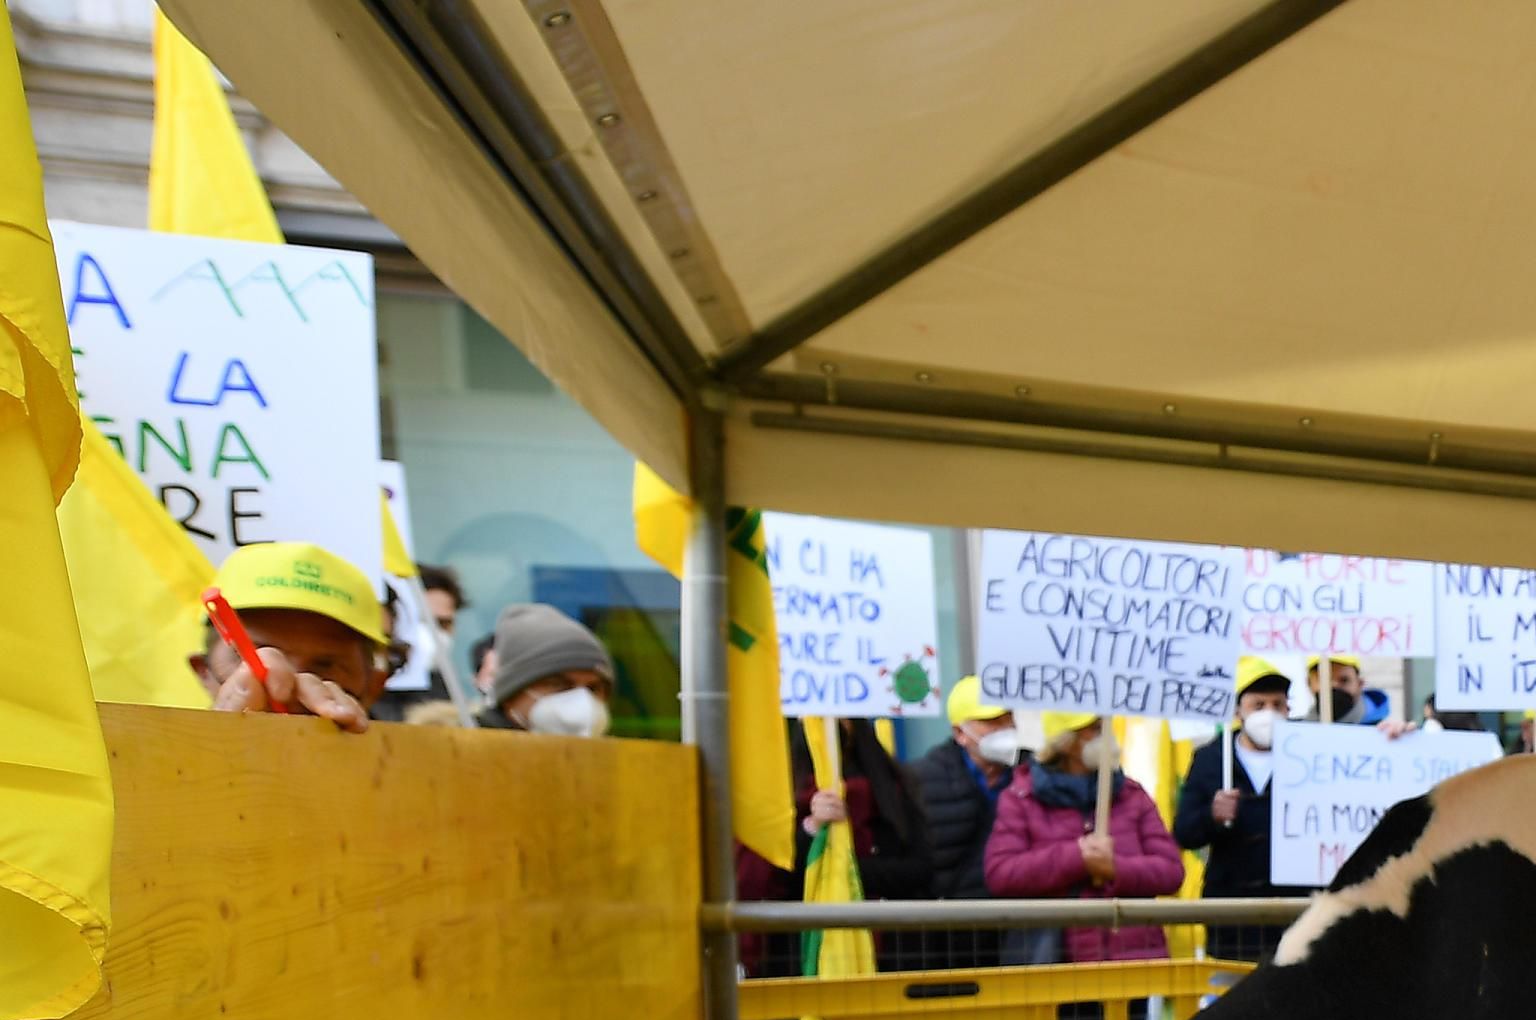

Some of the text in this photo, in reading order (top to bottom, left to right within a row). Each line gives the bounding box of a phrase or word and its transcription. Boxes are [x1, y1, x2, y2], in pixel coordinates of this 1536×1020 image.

[168, 352, 268, 409] LA
[161, 484, 276, 547] RE
[850, 546, 884, 588] HA
[1017, 534, 1230, 599] AGRICOLTORI
[986, 578, 1232, 638] E CONSUMATORI
[1243, 582, 1302, 614] CON
[857, 637, 887, 665] IL
[1047, 623, 1188, 676] VITTIME
[982, 662, 1232, 717] GUERRA DEI PREZZI
[1283, 734, 1392, 788] SENZA
[1283, 803, 1319, 838] LA
